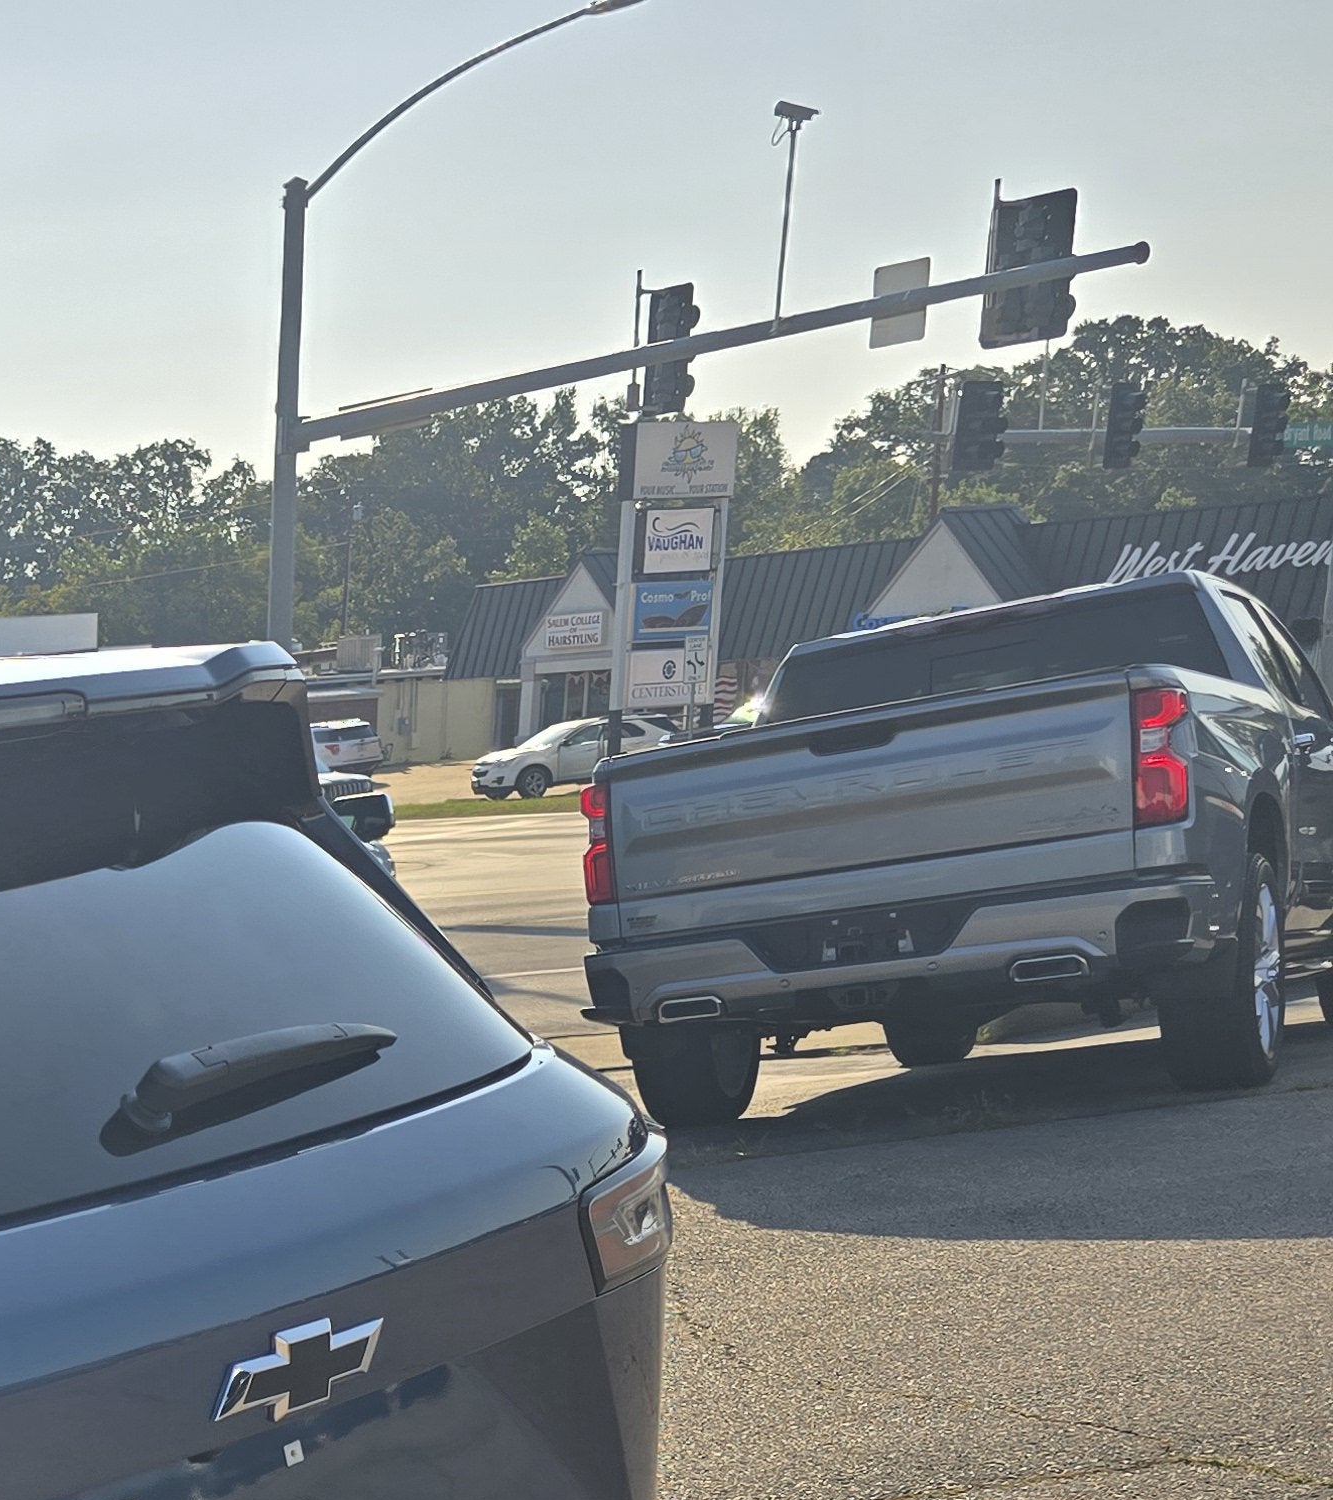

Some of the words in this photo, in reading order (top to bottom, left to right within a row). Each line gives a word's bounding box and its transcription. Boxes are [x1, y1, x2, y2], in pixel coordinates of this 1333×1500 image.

[648, 534, 703, 551] VAUGHAN
[1106, 541, 1204, 584] West
[1207, 532, 1332, 576] Haven
[641, 592, 674, 603] Cosmo
[570, 615, 601, 626] COLLEGE
[548, 633, 599, 647] HAIRSTYLING
[632, 684, 704, 699] CENTERSTOE
